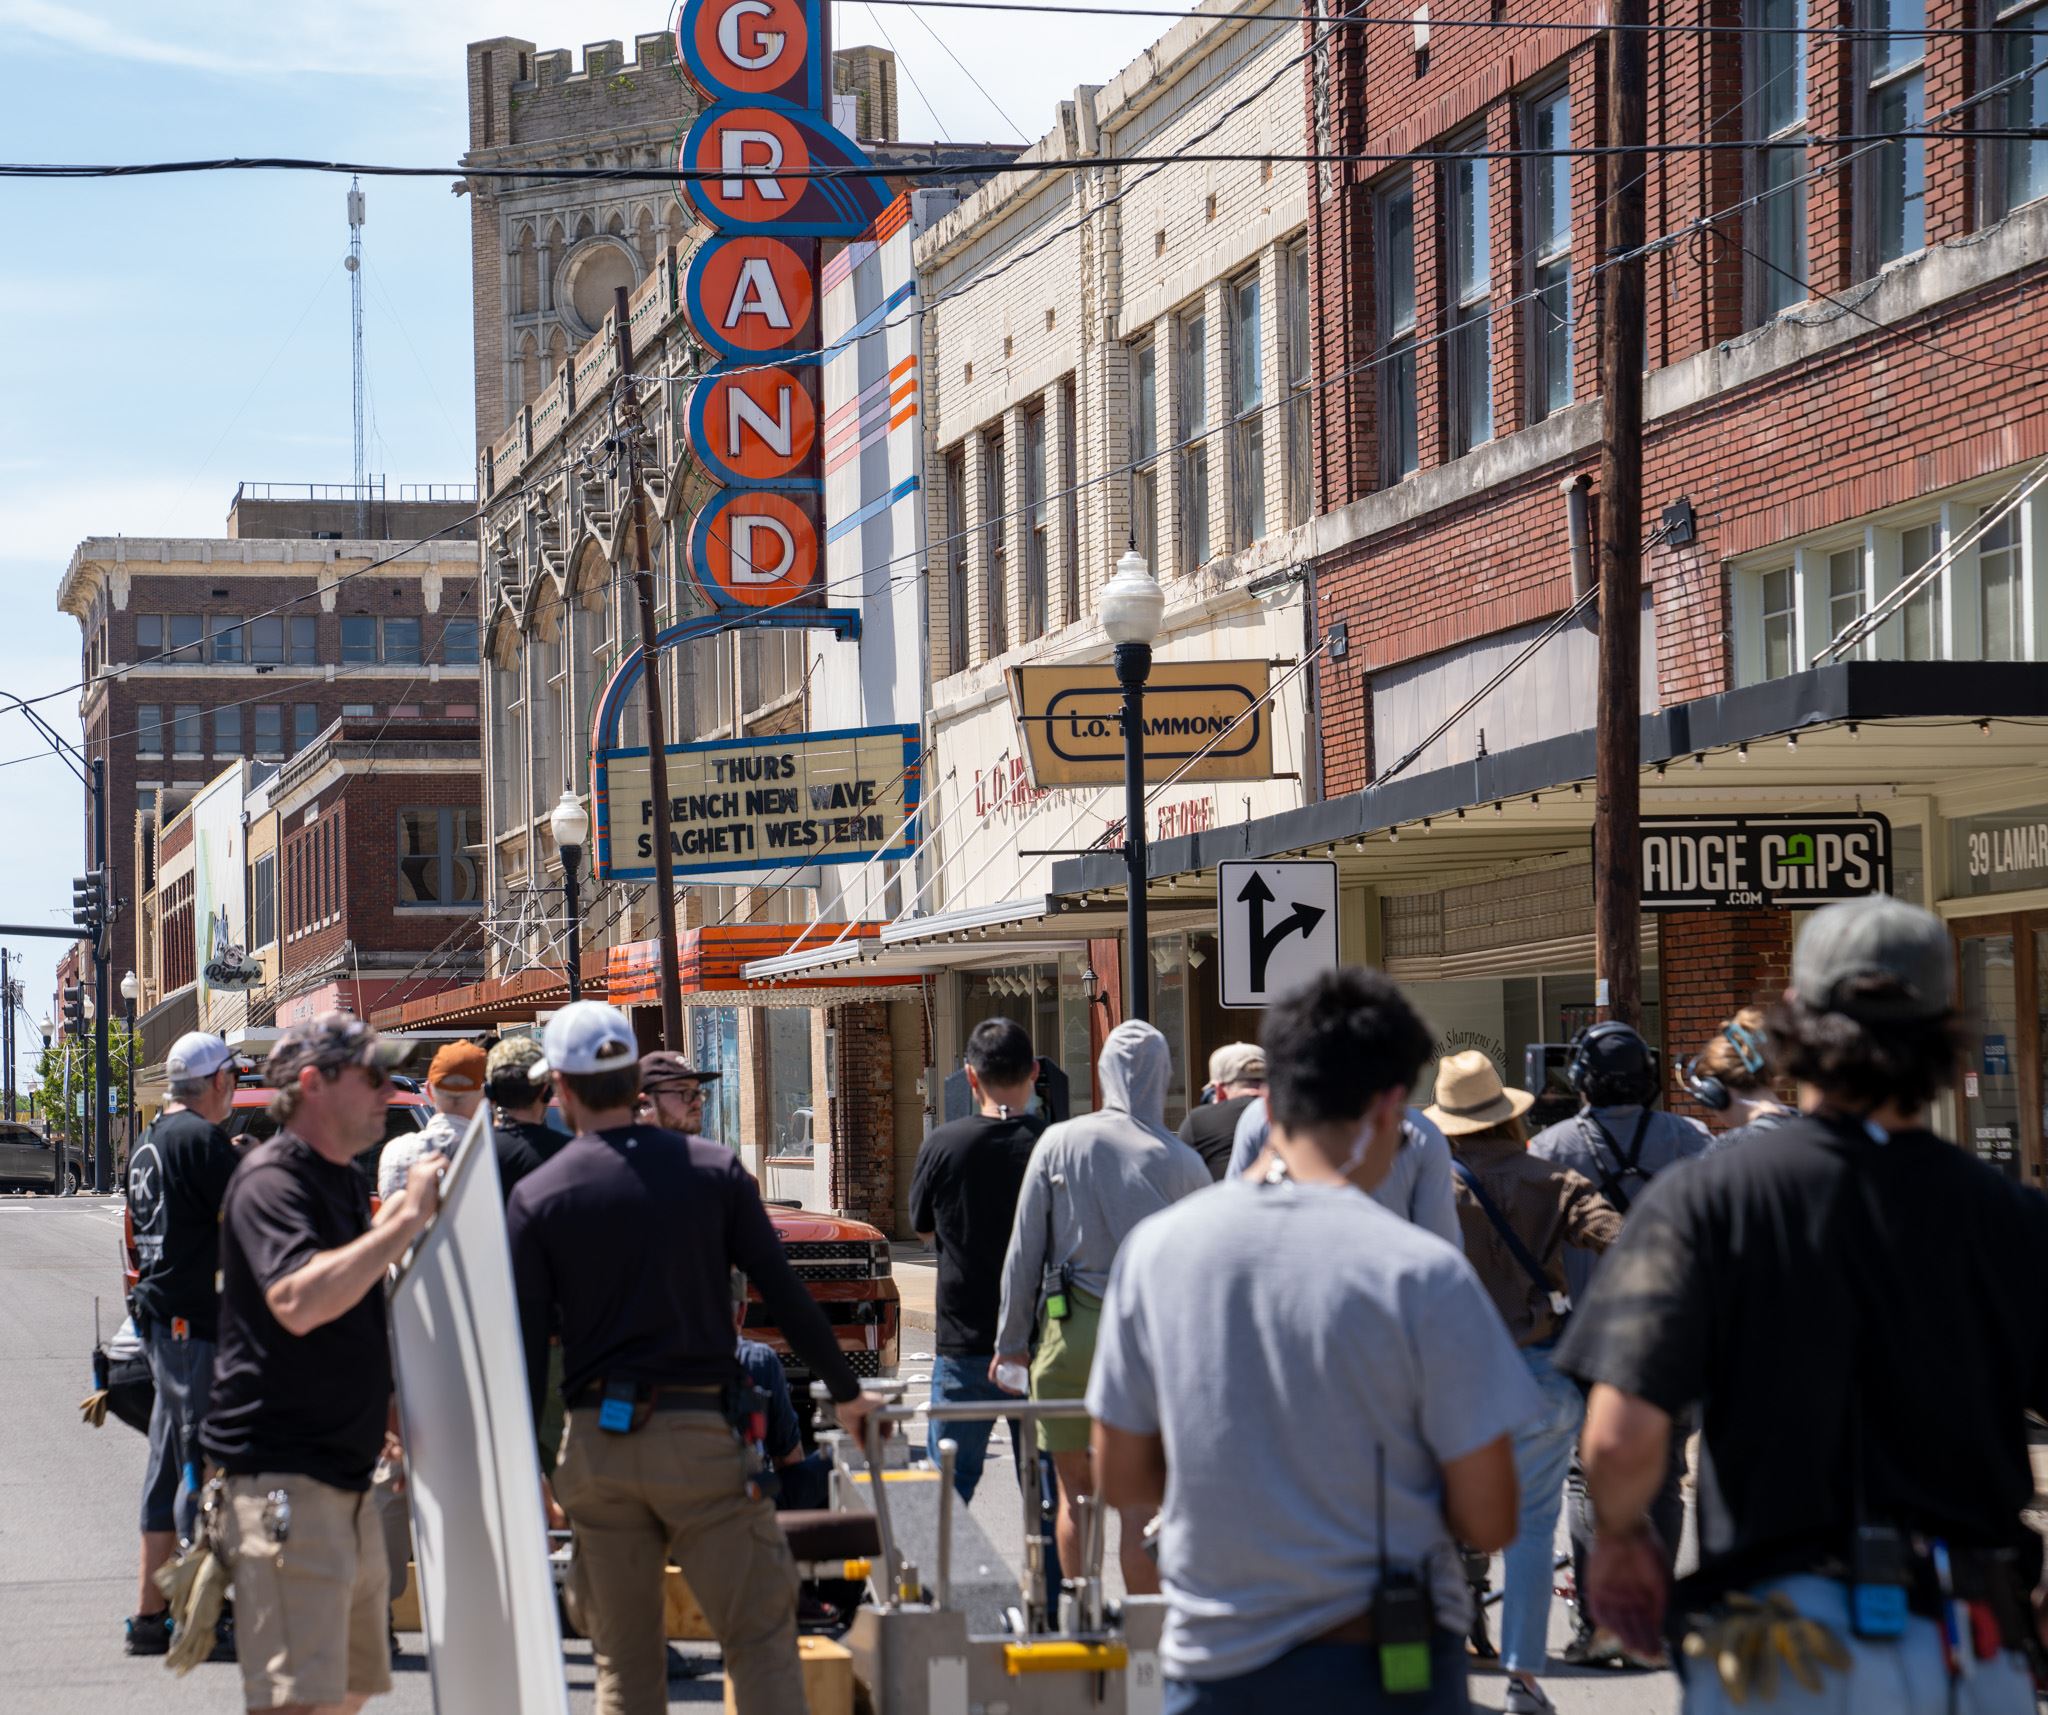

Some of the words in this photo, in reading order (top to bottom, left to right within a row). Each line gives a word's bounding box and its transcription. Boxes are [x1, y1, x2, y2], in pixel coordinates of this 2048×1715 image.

[717, 0, 796, 585] GRAND
[712, 754, 796, 784] THURS
[745, 788, 799, 816] NEW
[807, 780, 877, 811] WAVE
[637, 823, 755, 858] SAGHETI
[765, 814, 884, 848] WESTERN
[1760, 833, 1871, 890] CAPS
[1968, 832, 1990, 877] 39
[1725, 891, 1763, 905] .COM
[205, 963, 263, 983] Rigby's
[1446, 1027, 1490, 1050] Sharpens
